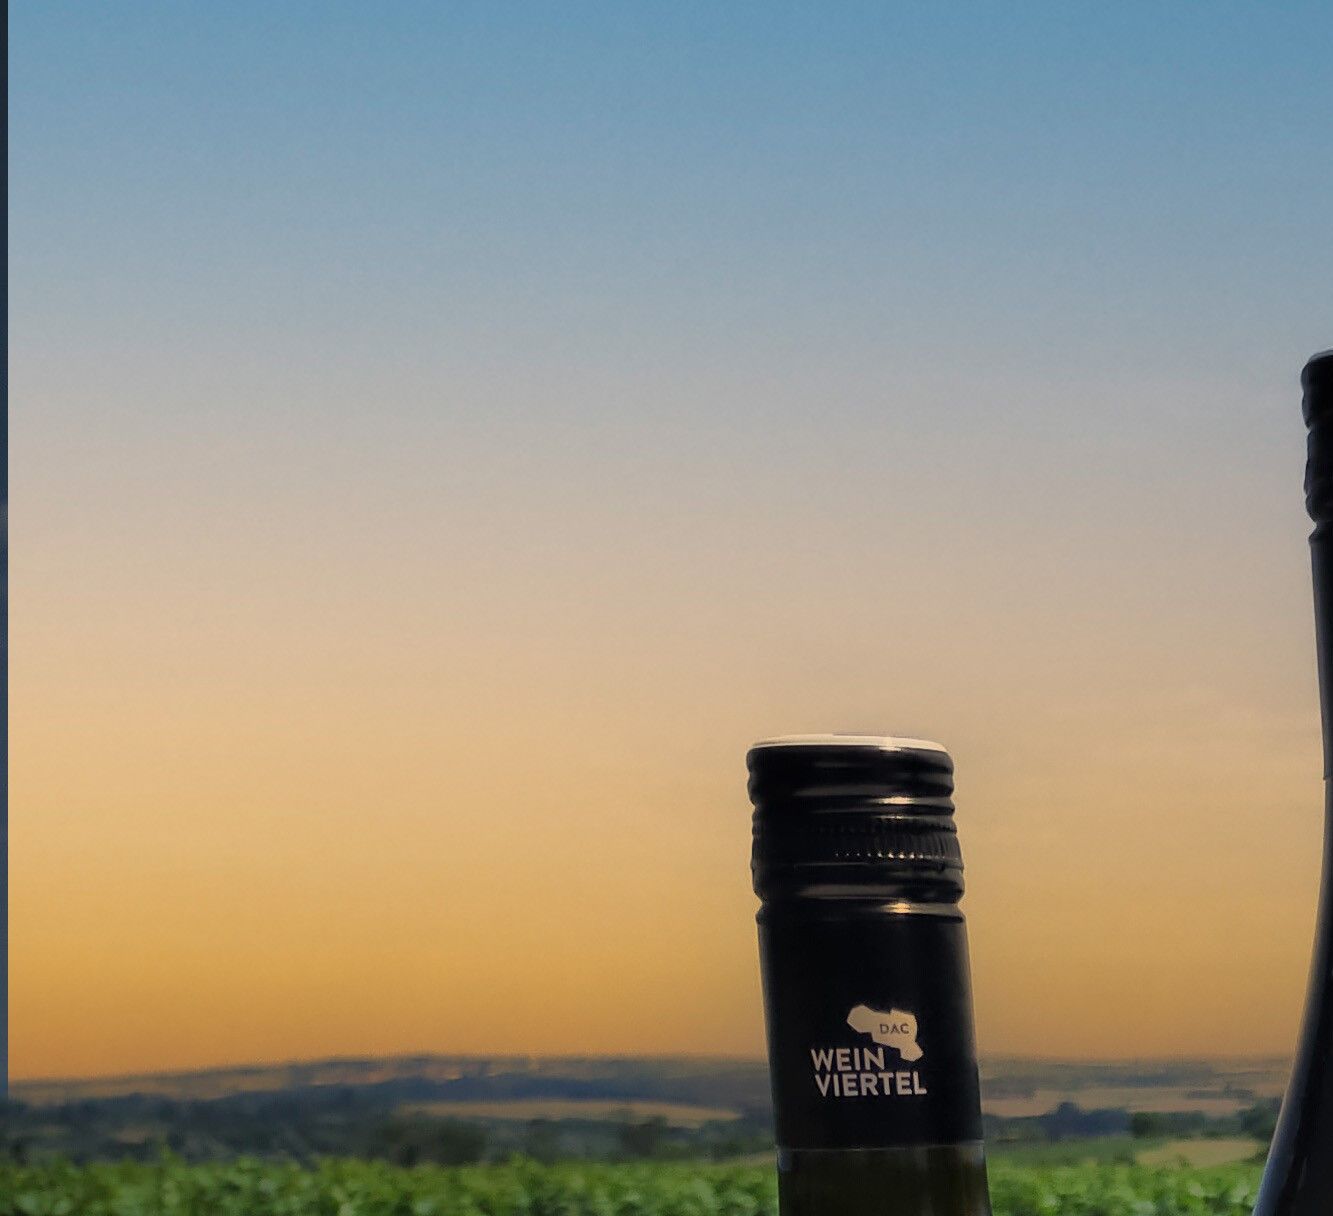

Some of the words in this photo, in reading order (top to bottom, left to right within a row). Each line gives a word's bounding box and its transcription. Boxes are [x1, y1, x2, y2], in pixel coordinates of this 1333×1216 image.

[879, 1022, 910, 1035] DAC
[811, 1046, 885, 1073] WEIN
[815, 1070, 928, 1098] VIERTEL
